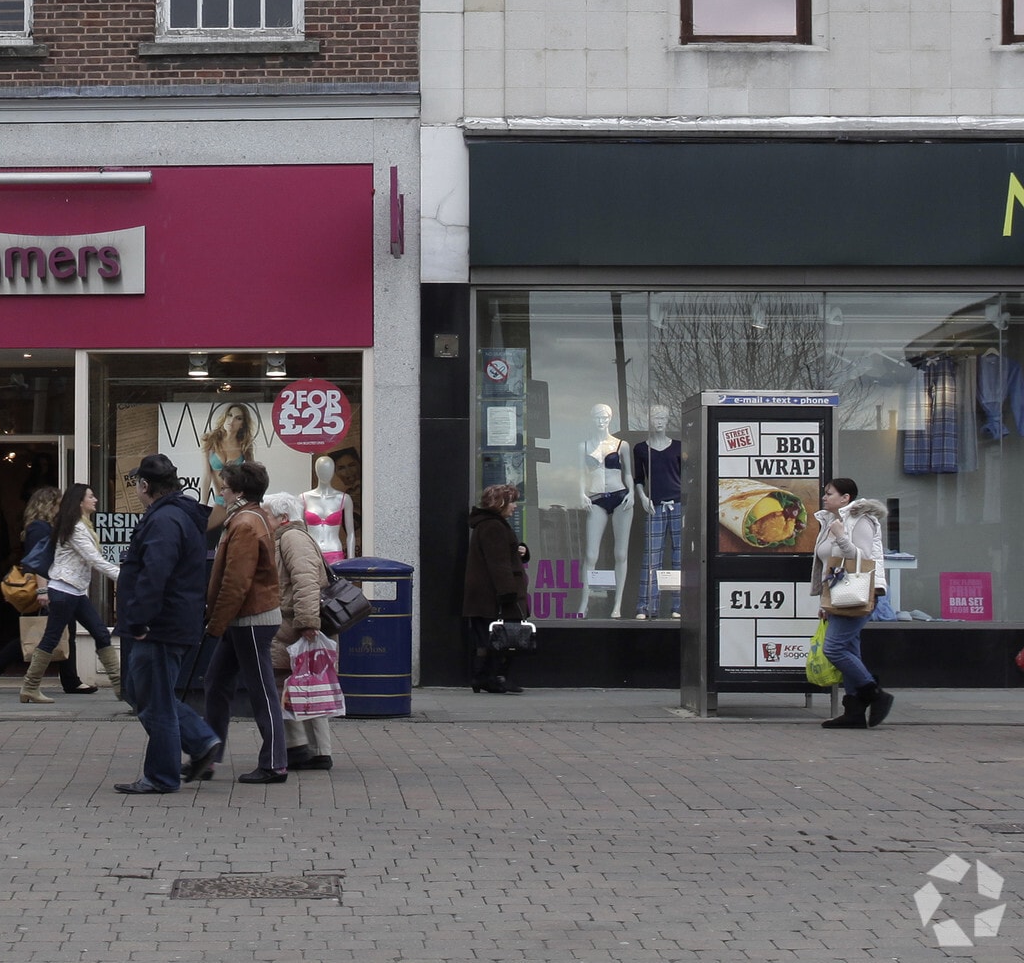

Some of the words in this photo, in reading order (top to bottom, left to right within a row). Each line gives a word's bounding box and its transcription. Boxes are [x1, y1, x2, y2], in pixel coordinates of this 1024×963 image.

[734, 396, 763, 404] e-mail
[800, 396, 829, 405] phone
[279, 405, 345, 435] £25
[725, 428, 749, 439] STREET
[727, 437, 752, 449] WISE
[776, 437, 815, 454] BBQ
[755, 458, 816, 475] WRAP
[96, 513, 144, 527] RISIN
[535, 559, 584, 589] ALL
[730, 590, 785, 610] £1.49
[949, 597, 967, 606] BRA
[968, 597, 984, 606] SET
[970, 606, 984, 614] £22
